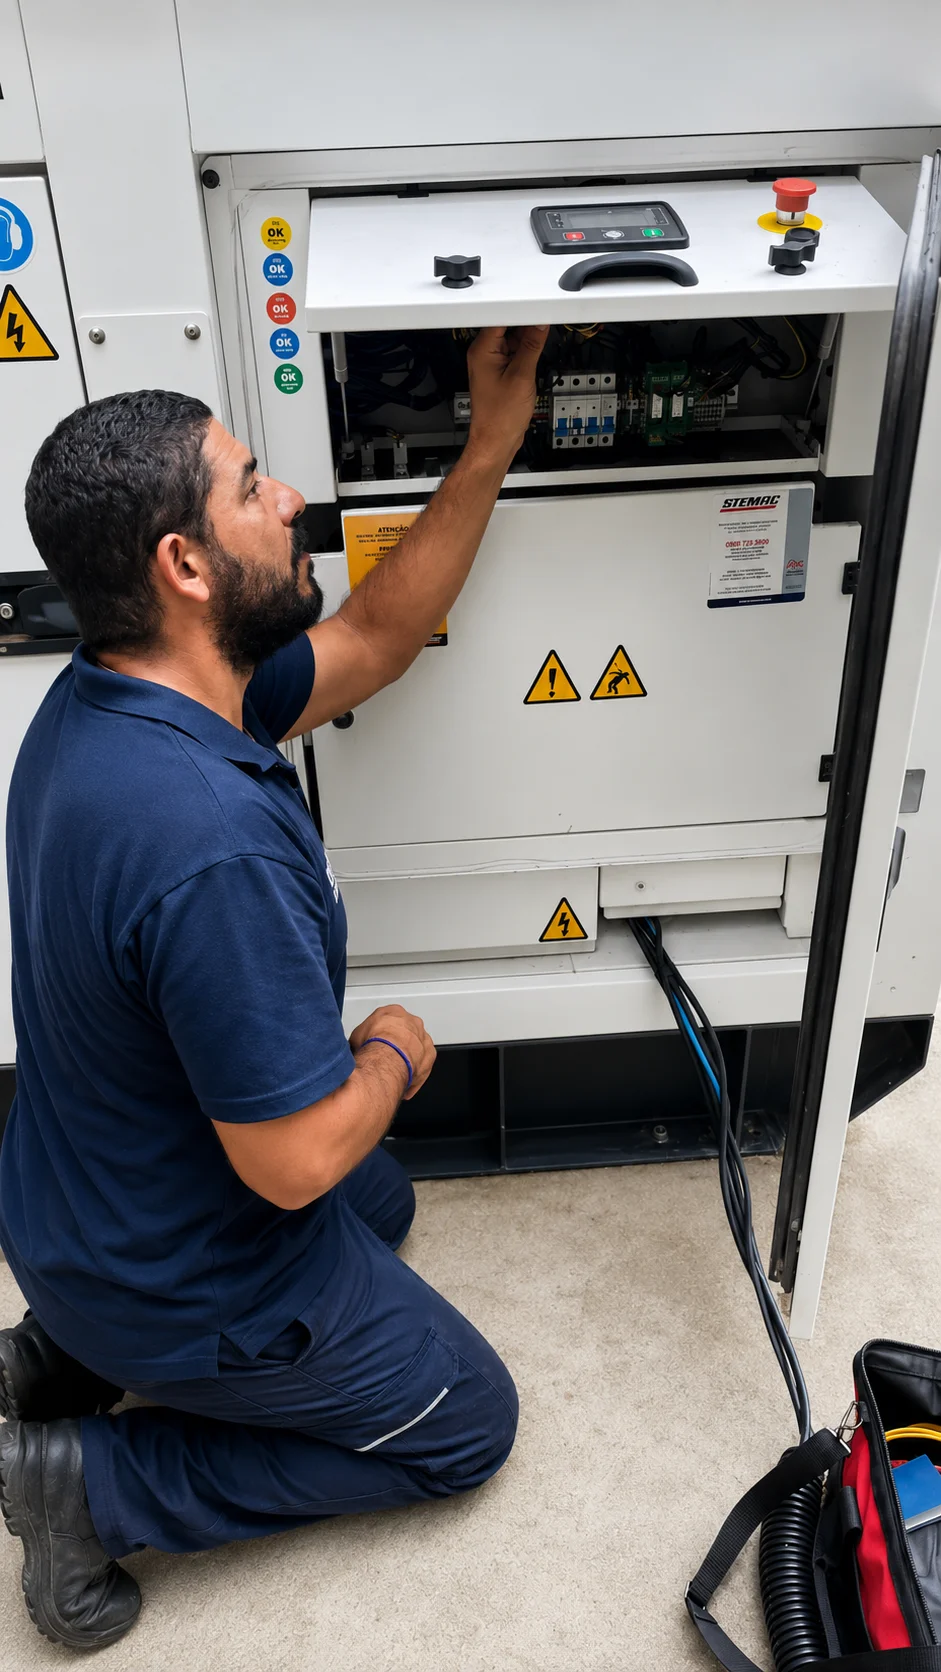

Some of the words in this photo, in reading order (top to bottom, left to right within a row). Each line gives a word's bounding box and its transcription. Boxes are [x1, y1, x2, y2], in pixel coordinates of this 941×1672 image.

[267, 228, 284, 237] OK
[269, 264, 285, 274] OK
[272, 304, 288, 313] OK
[276, 338, 292, 347] OK
[280, 373, 296, 382] OK
[722, 494, 781, 508] STEMAC
[377, 524, 409, 533] ATENÇÃO
